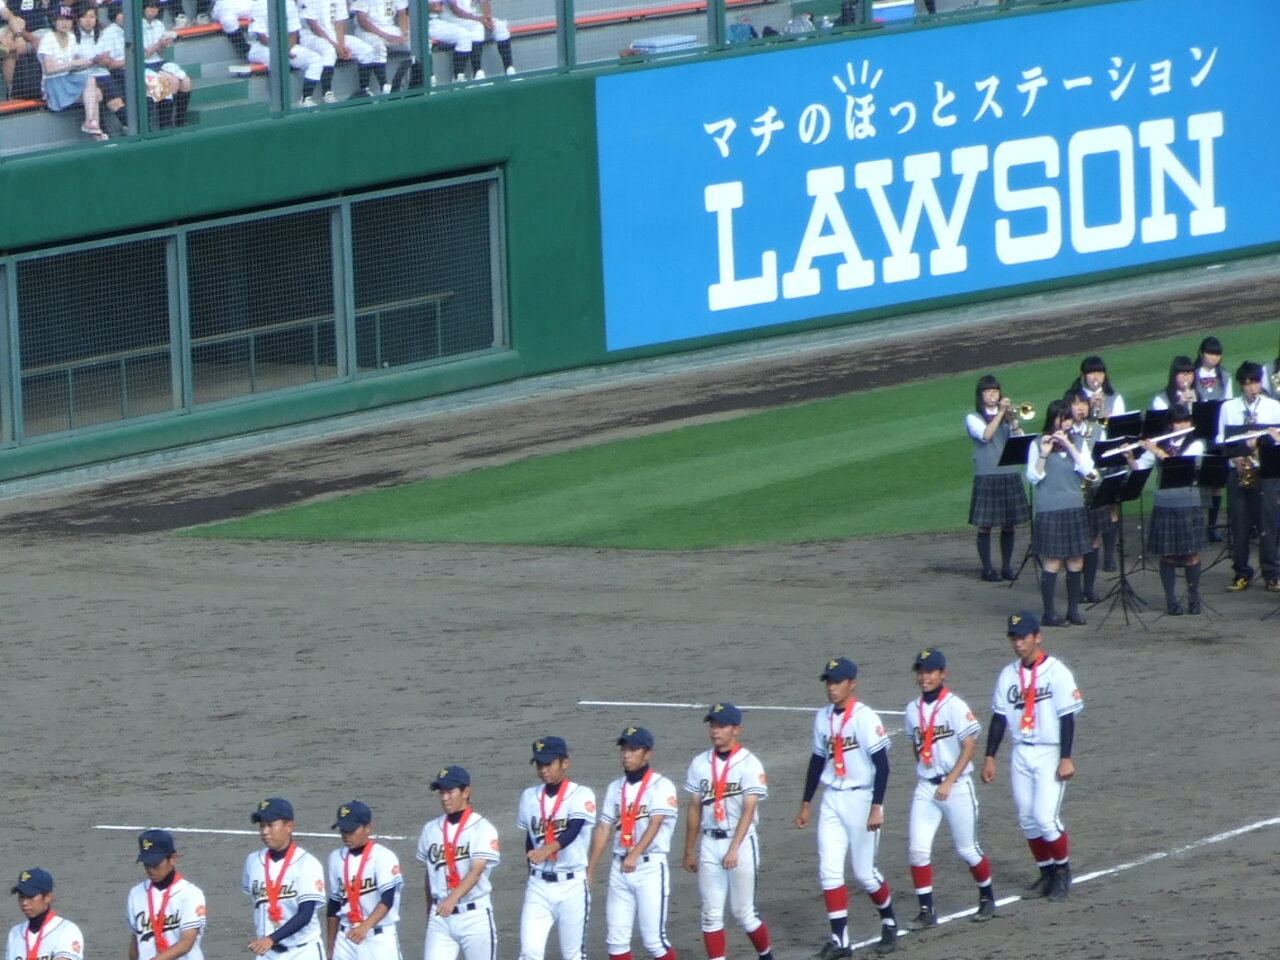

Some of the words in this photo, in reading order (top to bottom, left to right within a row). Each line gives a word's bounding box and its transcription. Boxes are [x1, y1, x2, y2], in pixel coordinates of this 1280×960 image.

[703, 47, 1220, 159] マチのほっとステーション
[704, 111, 1227, 312] LAWSON
